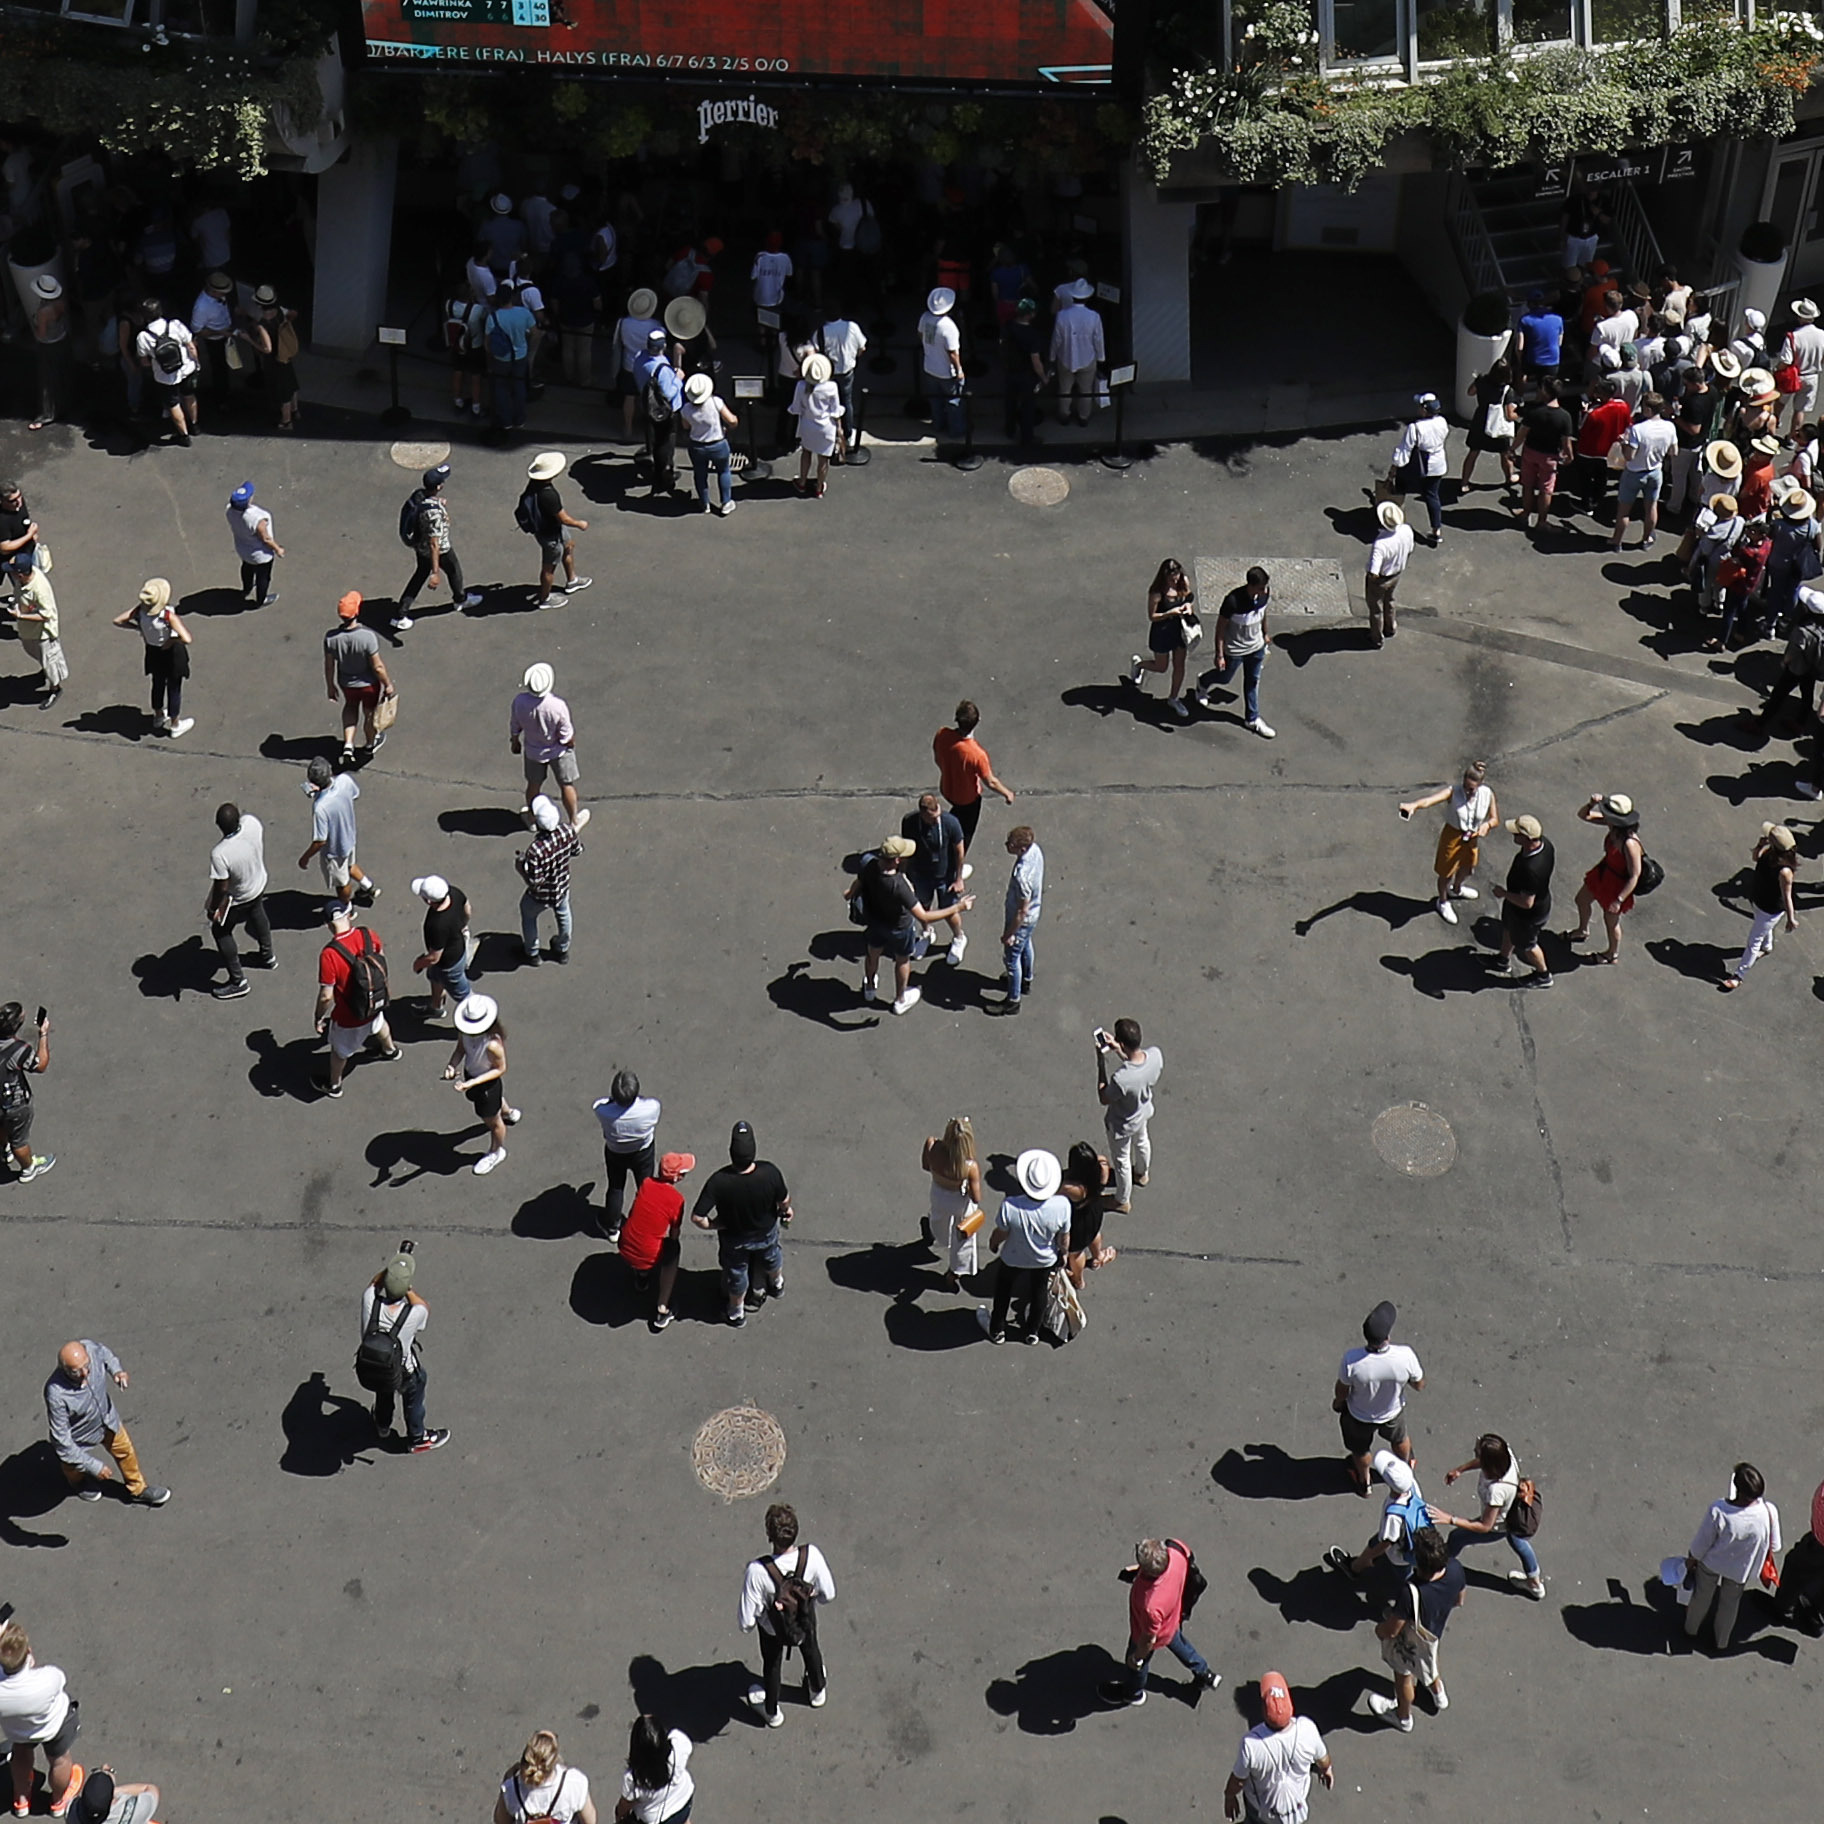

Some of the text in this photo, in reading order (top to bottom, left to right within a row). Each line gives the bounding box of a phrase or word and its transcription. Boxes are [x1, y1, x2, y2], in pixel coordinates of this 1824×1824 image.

[485, 1, 492, 9] 7
[500, 1, 507, 10] 7
[533, 2, 546, 11] 40
[414, 10, 468, 19] DIMITROV
[534, 14, 547, 22] 30
[602, 51, 651, 67] (FRA)
[655, 54, 684, 68] 6/7
[688, 55, 717, 69] 6/3
[722, 56, 750, 71] 2/5
[696, 94, 779, 145] perrier
[1586, 165, 1650, 182] ESCALIER 1
